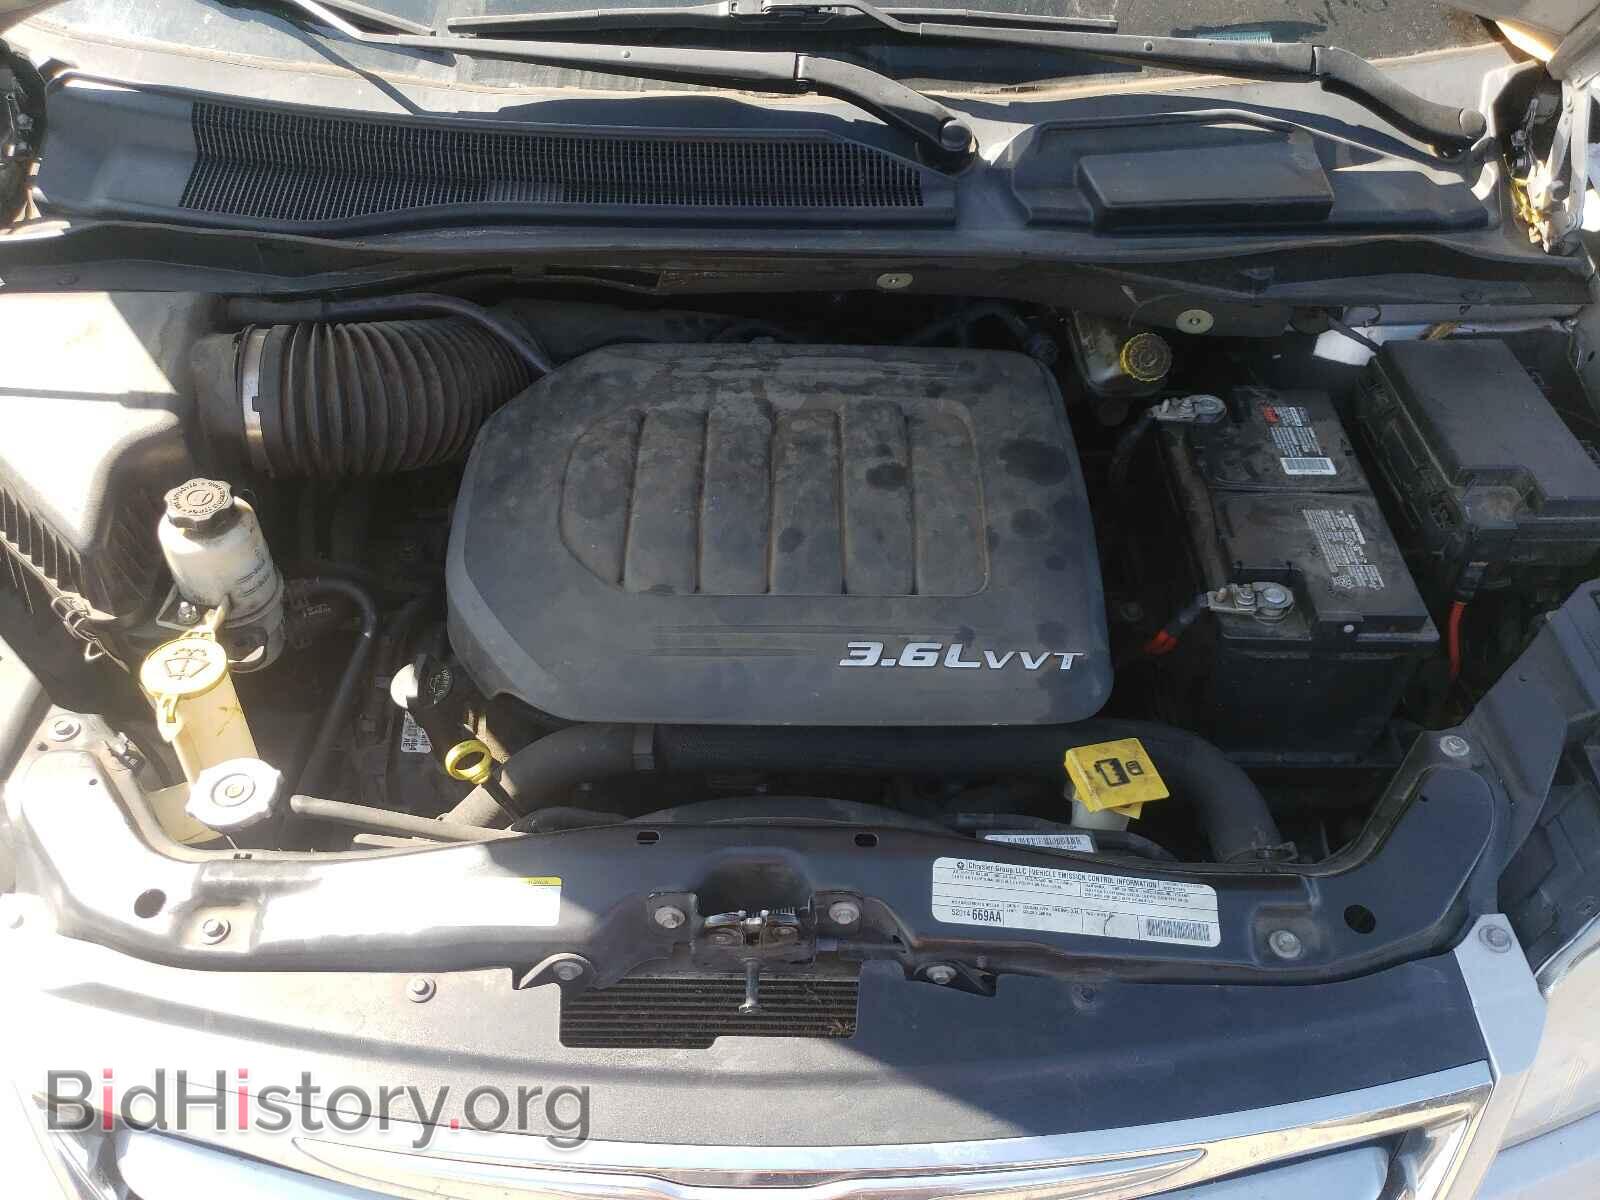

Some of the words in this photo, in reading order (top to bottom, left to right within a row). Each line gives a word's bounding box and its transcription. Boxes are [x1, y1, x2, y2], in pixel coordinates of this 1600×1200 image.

[968, 861, 993, 872] Chrysler
[995, 864, 1013, 874] Group
[1015, 866, 1027, 875] LLC
[1031, 868, 1056, 878] VEHICLE
[1058, 871, 1086, 881] EMISSION
[1088, 874, 1115, 884] CONTROL
[1116, 878, 1157, 889] INFORMATION
[972, 909, 1002, 922] 669AA
